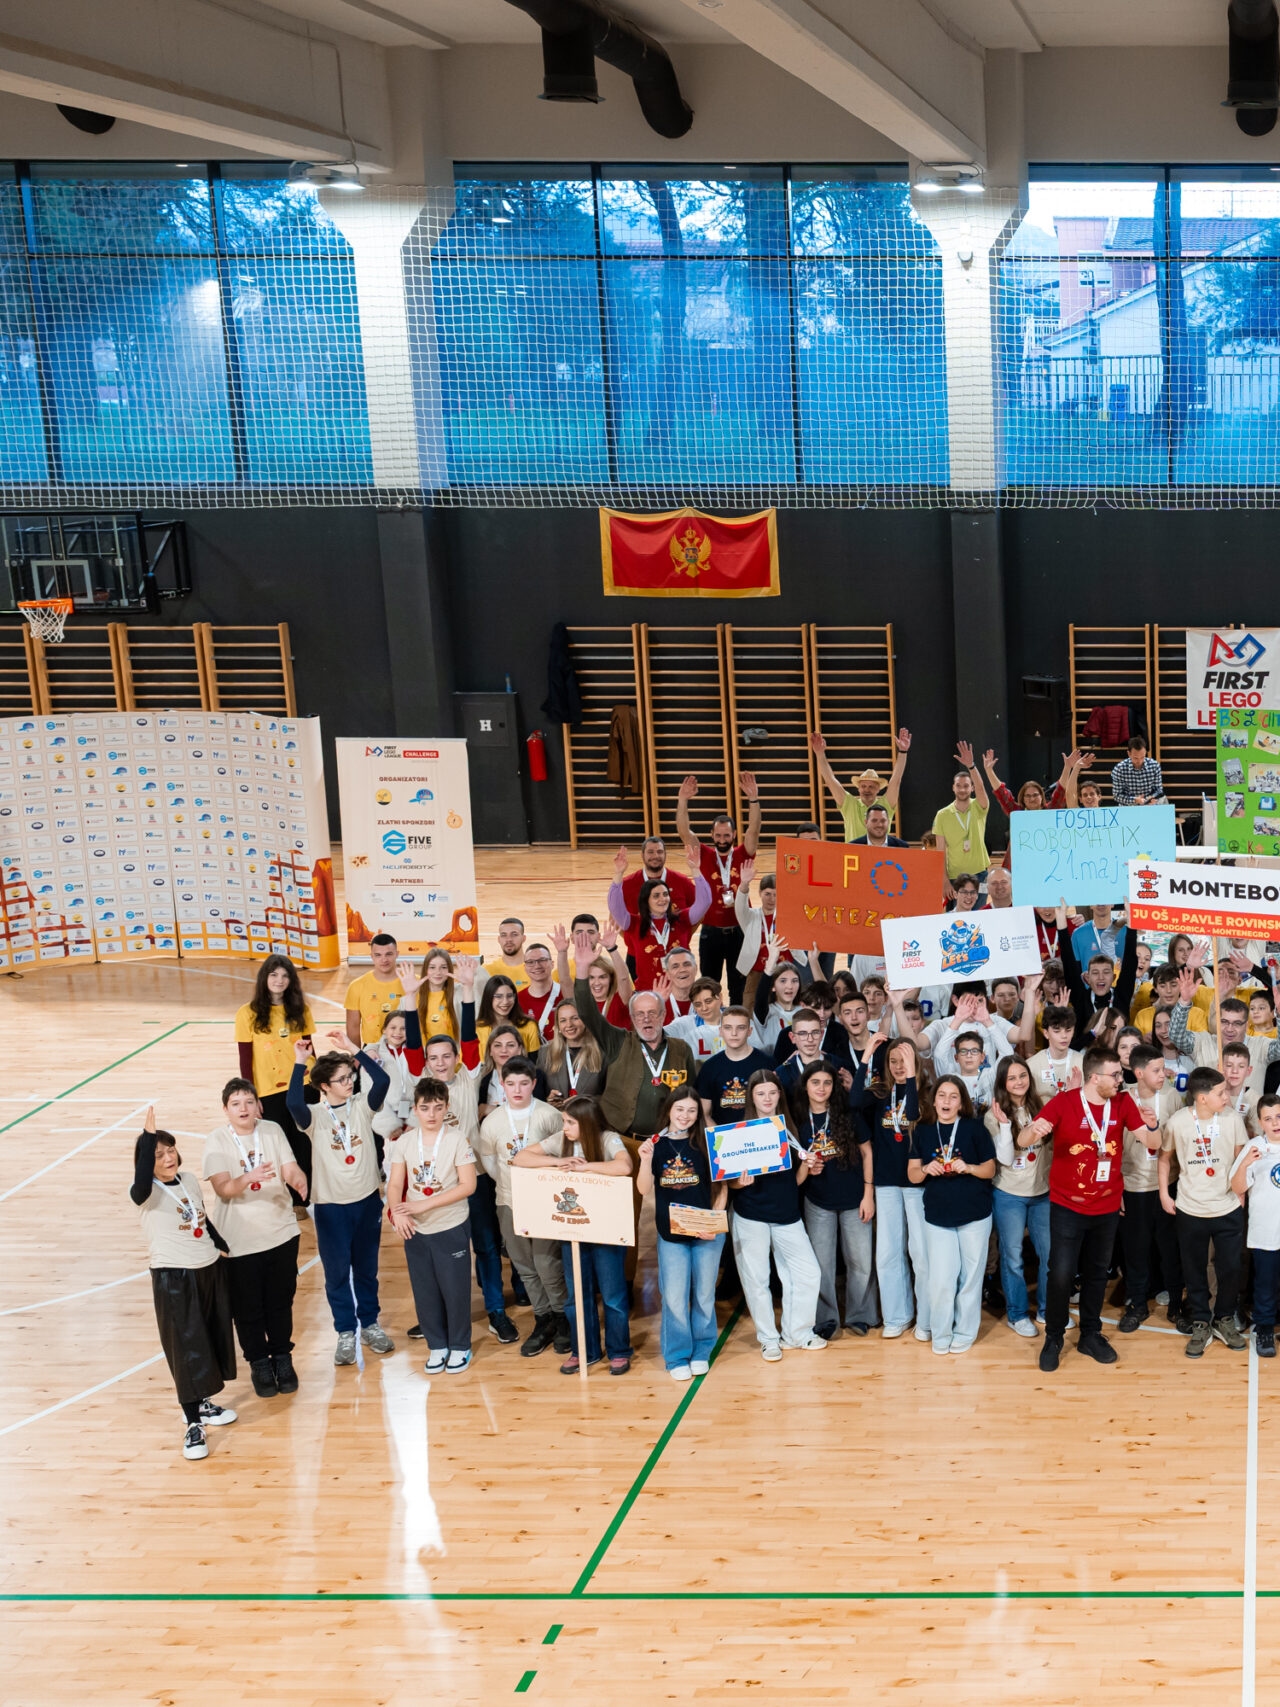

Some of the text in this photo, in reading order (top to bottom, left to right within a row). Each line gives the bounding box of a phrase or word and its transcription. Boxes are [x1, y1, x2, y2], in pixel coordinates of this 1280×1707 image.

[1203, 672, 1269, 690] FIRST
[1208, 692, 1262, 708] LEGO
[479, 720, 492, 732] H
[1056, 808, 1119, 829] FOSILIX
[408, 836, 432, 844] FIVE
[1018, 825, 1140, 851] ROBOMATIX
[804, 904, 904, 927] VITEZ
[1133, 909, 1148, 919] JU
[1152, 909, 1168, 921] OŠ
[1182, 913, 1223, 926] PAVLE
[1157, 923, 1206, 934] PODGORICA
[1212, 929, 1270, 939] MONTENEGRO
[902, 950, 922, 958] FIRST
[722, 1144, 779, 1158] GROUNDBREAKERS
[661, 1176, 699, 1184] BREAKERS
[552, 1214, 565, 1222] DIG
